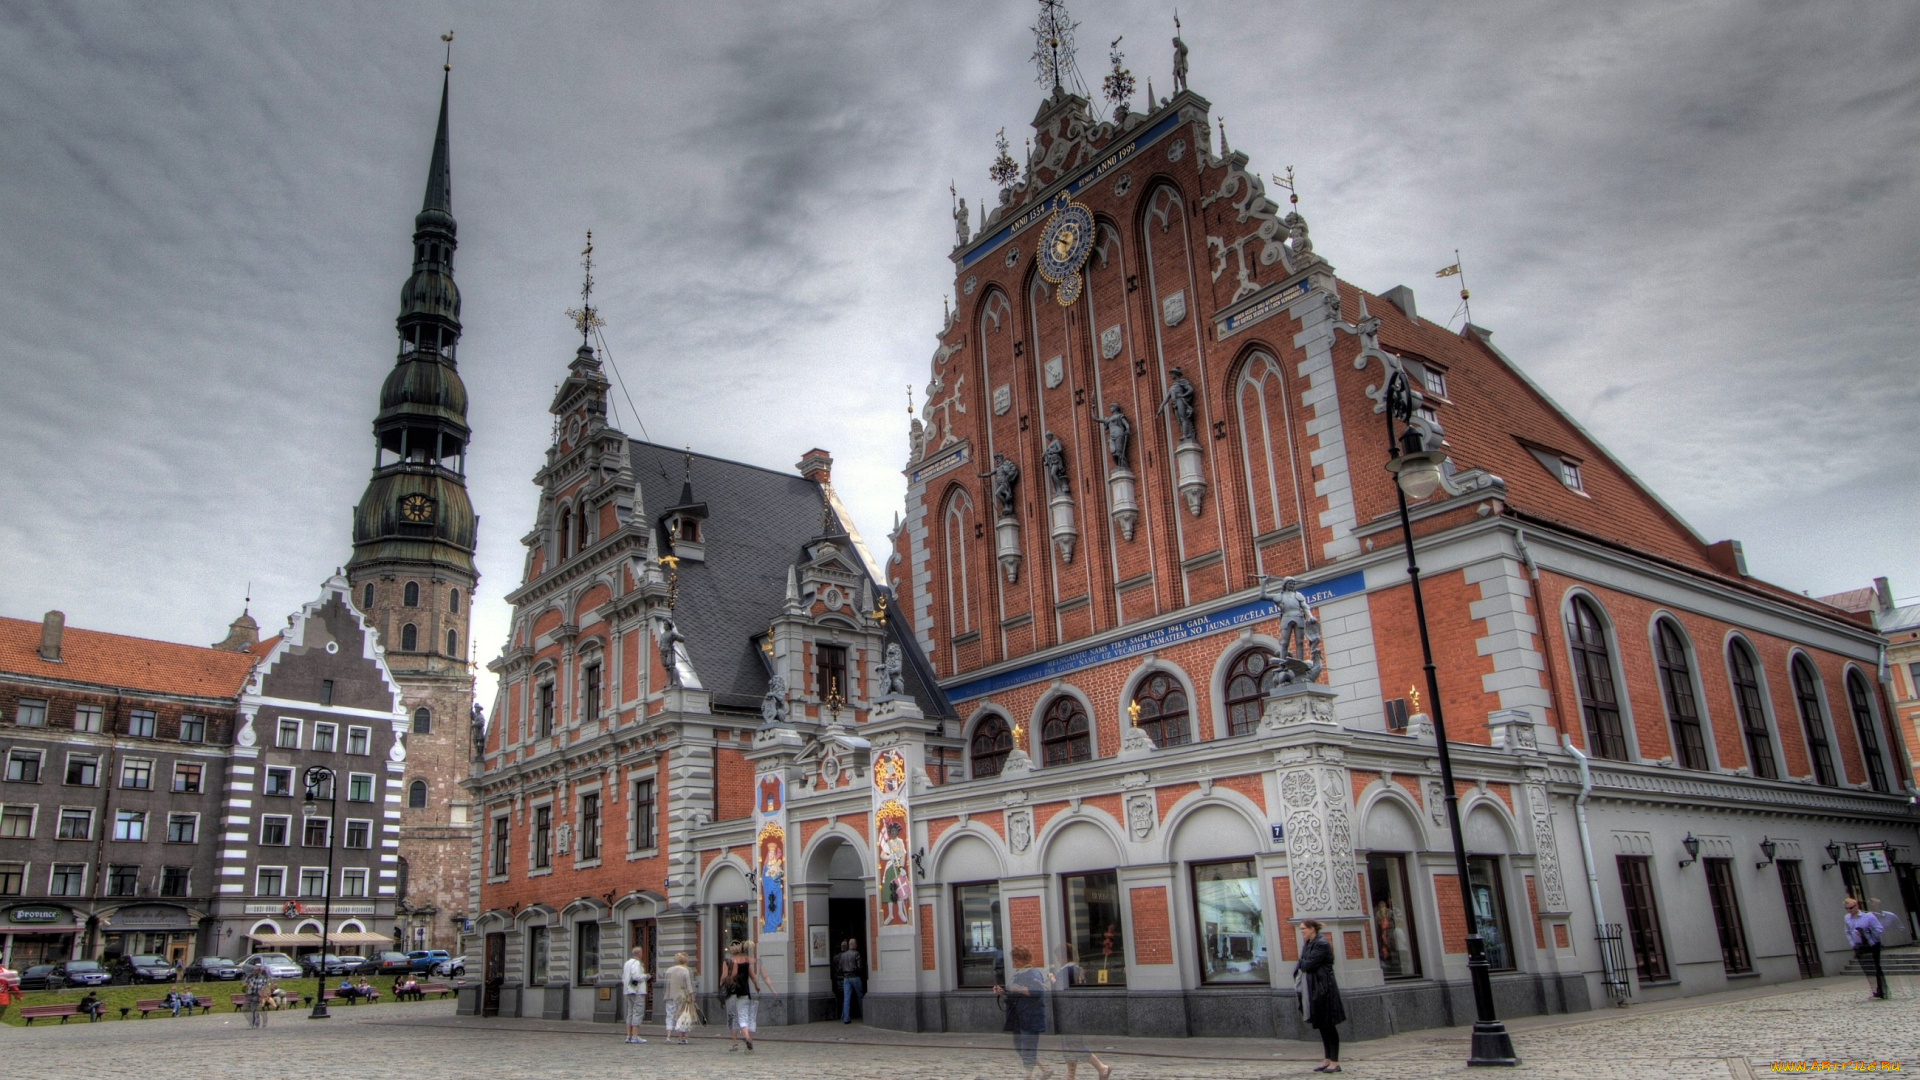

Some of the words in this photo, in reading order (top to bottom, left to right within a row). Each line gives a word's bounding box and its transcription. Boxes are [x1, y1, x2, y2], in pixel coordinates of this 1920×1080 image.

[1010, 215, 1028, 234] ANNO
[1096, 157, 1117, 176] ANNO
[1119, 142, 1136, 159] 1999
[1078, 655, 1100, 667] NAMU
[1101, 651, 1112, 660] UZ
[1150, 631, 1188, 646] PAMATIEM
[1190, 626, 1202, 636] NO
[1205, 619, 1231, 633] JAUNA
[1233, 608, 1266, 624] UZCĒLA
[1089, 645, 1108, 656] NAMS
[1111, 640, 1127, 650] TIKA
[1129, 630, 1165, 644] SAGRAUTS
